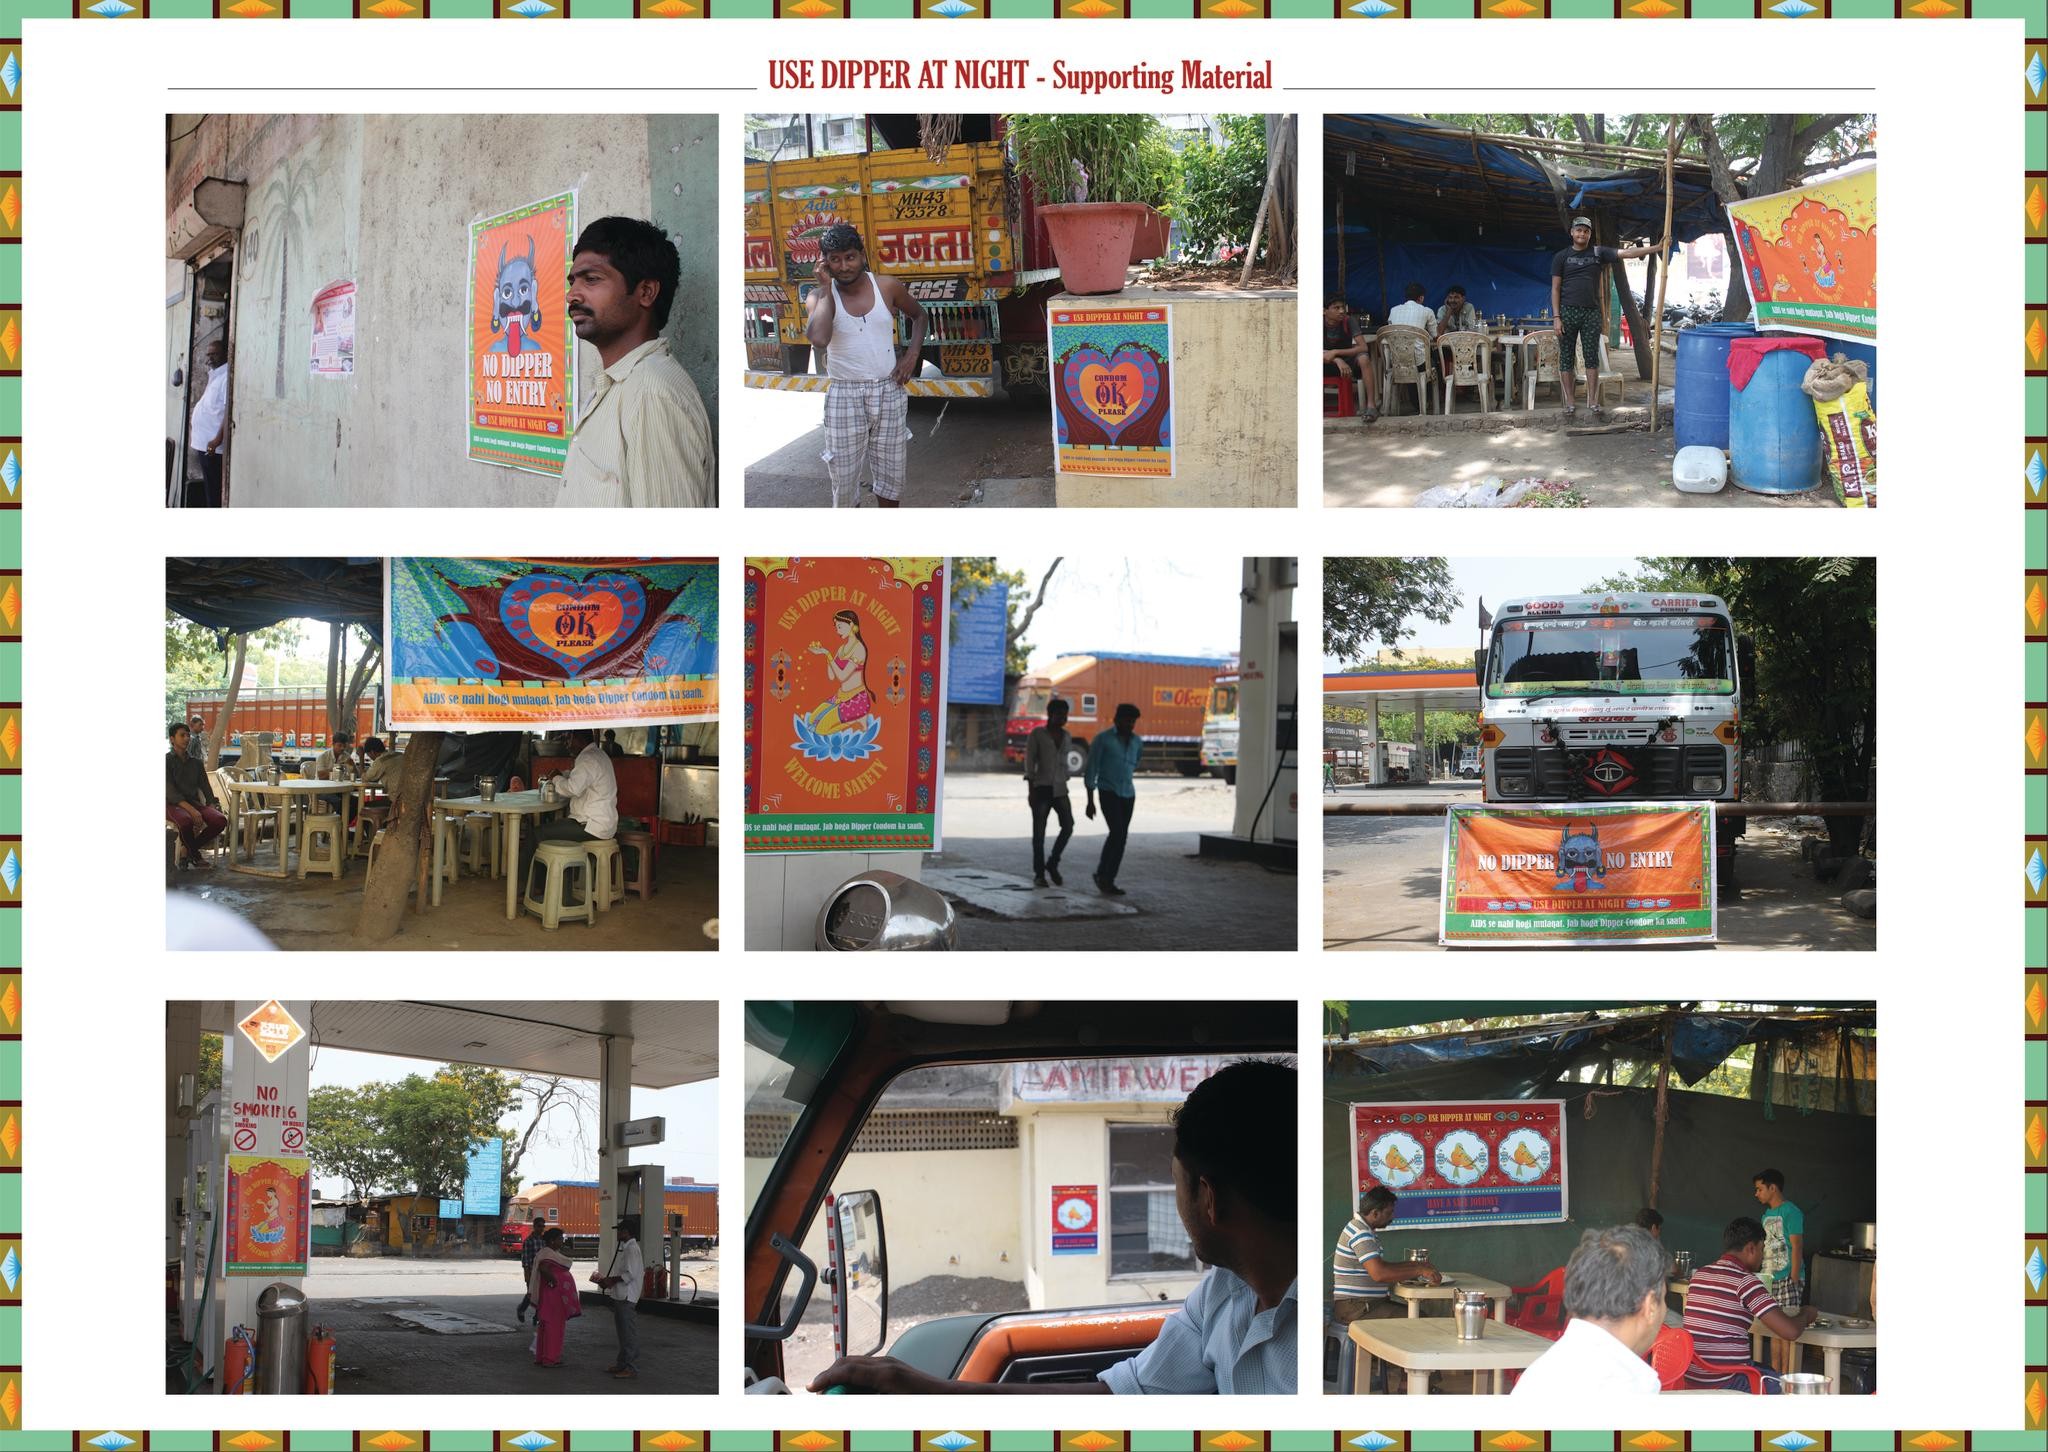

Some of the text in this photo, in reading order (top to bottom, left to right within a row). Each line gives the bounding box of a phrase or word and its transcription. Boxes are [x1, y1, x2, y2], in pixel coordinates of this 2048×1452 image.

[898, 191, 945, 206] MH43
[877, 230, 973, 267] जनता
[903, 280, 959, 299] EASE
[1073, 311, 1144, 322] USE DIPPER AT NIGHT
[482, 352, 553, 379] NO DIPPER
[1094, 374, 1127, 382] CONDOM
[486, 380, 548, 407] NO ENTRY
[1095, 382, 1128, 409] OK
[1098, 408, 1127, 416] PLEASE
[487, 414, 498, 425] USE
[498, 415, 519, 428] DIPPER
[527, 419, 548, 431] NIGHT
[555, 602, 601, 612] CONDOM
[777, 585, 902, 636] USE DIPPER AT NIGHT
[1524, 598, 1700, 610] GOODS CARRIER
[554, 611, 600, 640] OK
[556, 639, 595, 648] PLEASE
[423, 692, 446, 705] AIDS
[448, 694, 459, 705] se
[461, 692, 485, 705] nahi
[487, 692, 510, 706] hogi
[511, 694, 553, 707] mulaqat.
[555, 693, 571, 706] Jab
[573, 693, 597, 705] hoga
[598, 692, 629, 705] Dipper
[631, 690, 667, 702] Condom
[669, 688, 680, 700] ka
[1589, 729, 1627, 740] TATA
[783, 756, 889, 800] WELCOME SAFETY
[744, 823, 753, 831] DS
[762, 822, 777, 831] nahi
[778, 822, 793, 832] hogi
[822, 822, 834, 831] Jab
[834, 822, 850, 831] hoga
[851, 822, 872, 832] Dipper
[872, 822, 897, 830] Condom
[897, 822, 906, 830] ka
[1478, 850, 1675, 871] NO DIPPER NO ENTRY
[1533, 898, 1625, 910] USE DIPPER AT NIGHT
[1471, 919, 1487, 928] AIDS
[1488, 920, 1496, 928] se
[1497, 919, 1514, 928] nahi
[1515, 919, 1532, 929] hogi
[1566, 919, 1579, 929] Jab
[1580, 919, 1599, 928] hoga
[1600, 918, 1624, 928] Dipper
[1625, 917, 1654, 926] Condom
[1655, 917, 1665, 926] ka
[256, 1085, 279, 1101] NO
[1428, 1112, 1492, 1122] USE DIPPER AT NIGHT
